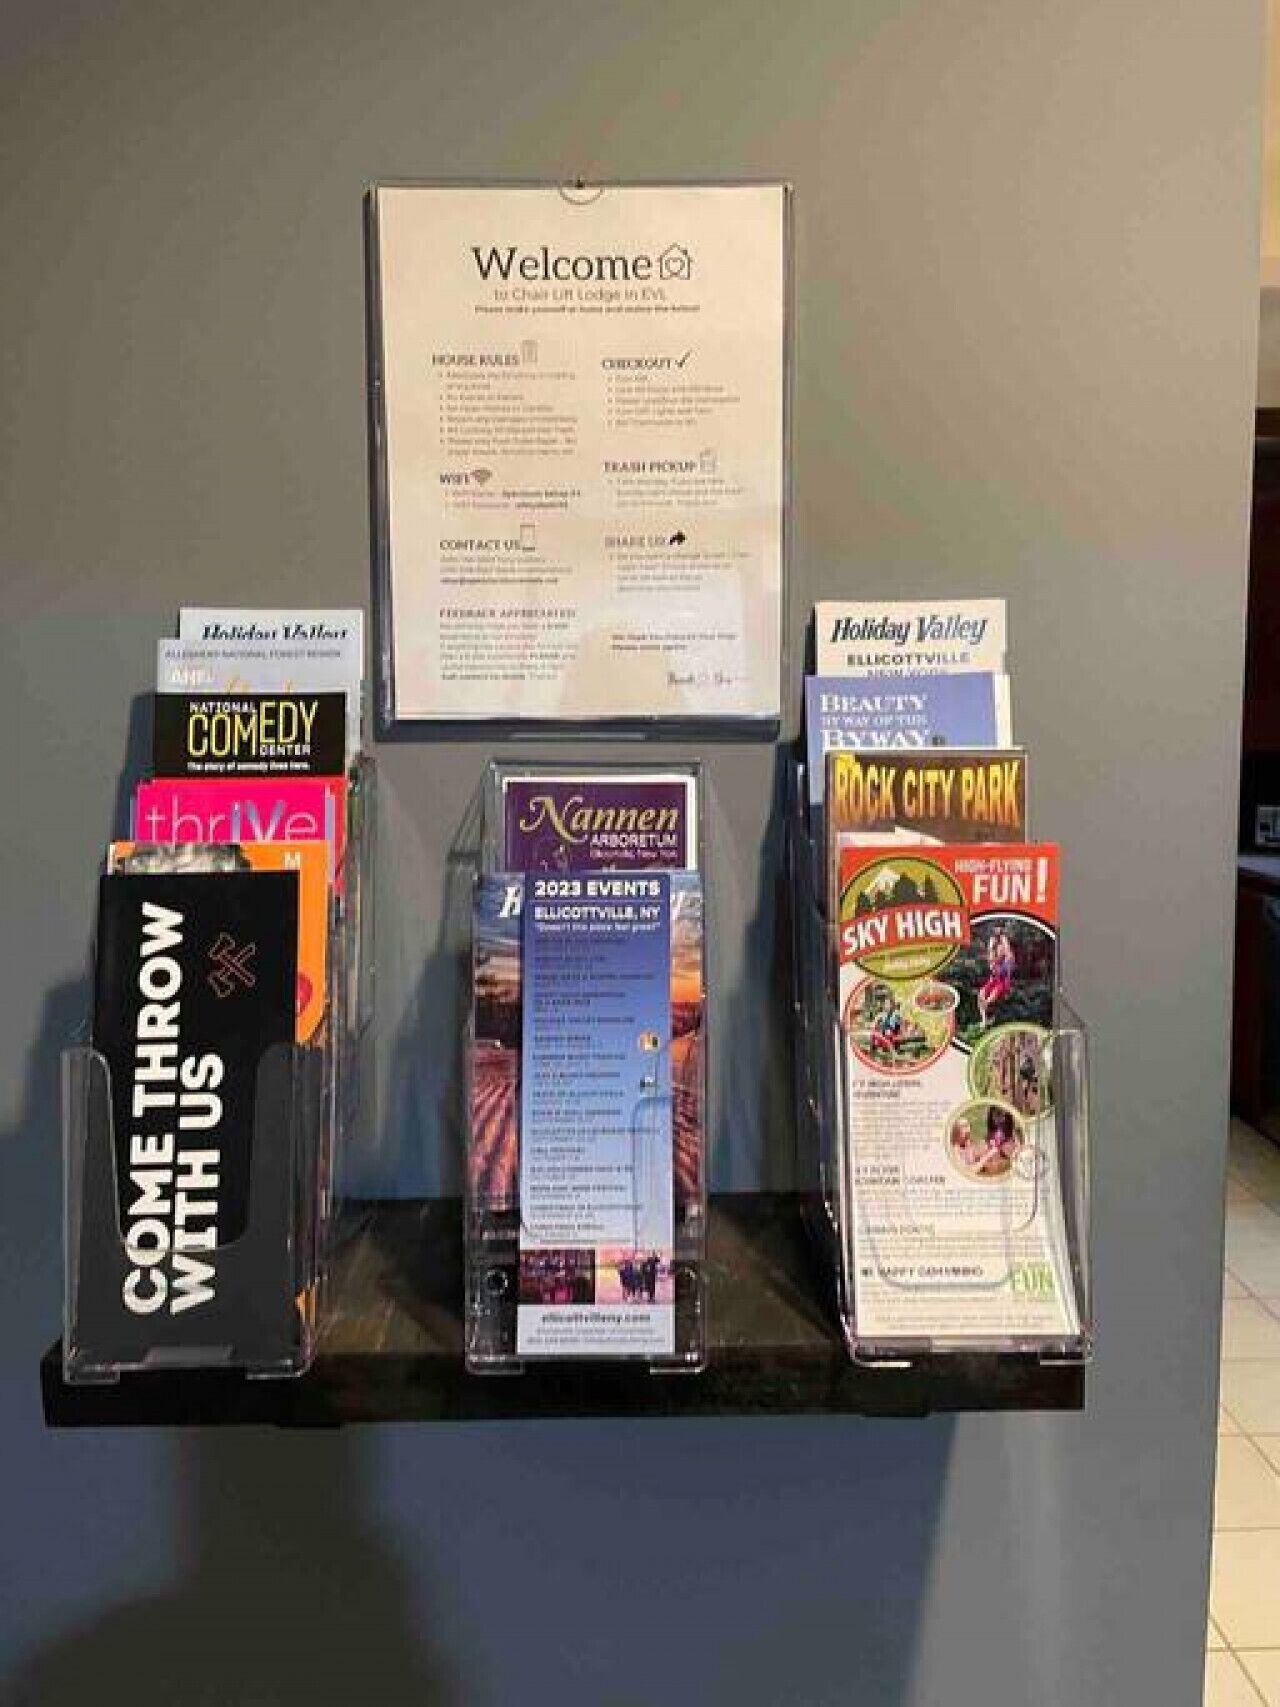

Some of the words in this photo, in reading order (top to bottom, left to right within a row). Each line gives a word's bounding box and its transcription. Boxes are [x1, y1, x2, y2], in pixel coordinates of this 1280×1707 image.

[472, 245, 652, 282] Welcome
[512, 287, 549, 302] Chair
[577, 287, 621, 305] Lodge
[440, 539, 500, 551] CONTACT
[831, 616, 911, 645] Holiday
[917, 614, 988, 645] Valley
[847, 652, 970, 666] ELLICOTTVILLE
[189, 701, 257, 713] NATIONAL
[820, 693, 928, 712] BEAUTY
[187, 701, 318, 757] COMEDY
[820, 729, 931, 748] BYWAY
[259, 744, 310, 756] CENTER
[834, 754, 896, 826] ROCK
[903, 768, 955, 819] CITY
[960, 759, 1021, 827] PARK
[519, 796, 679, 843] Nannen
[589, 833, 678, 848] ARBORETUM
[534, 879, 581, 896] 2023
[586, 879, 661, 896] EVENTS
[640, 906, 661, 921] NY
[842, 915, 888, 957] SKY
[895, 909, 962, 940] HIGH
[133, 901, 185, 1117] THROW
[179, 1052, 225, 1131] US
[122, 1132, 175, 1315] COME
[170, 1148, 222, 1315] WITH
